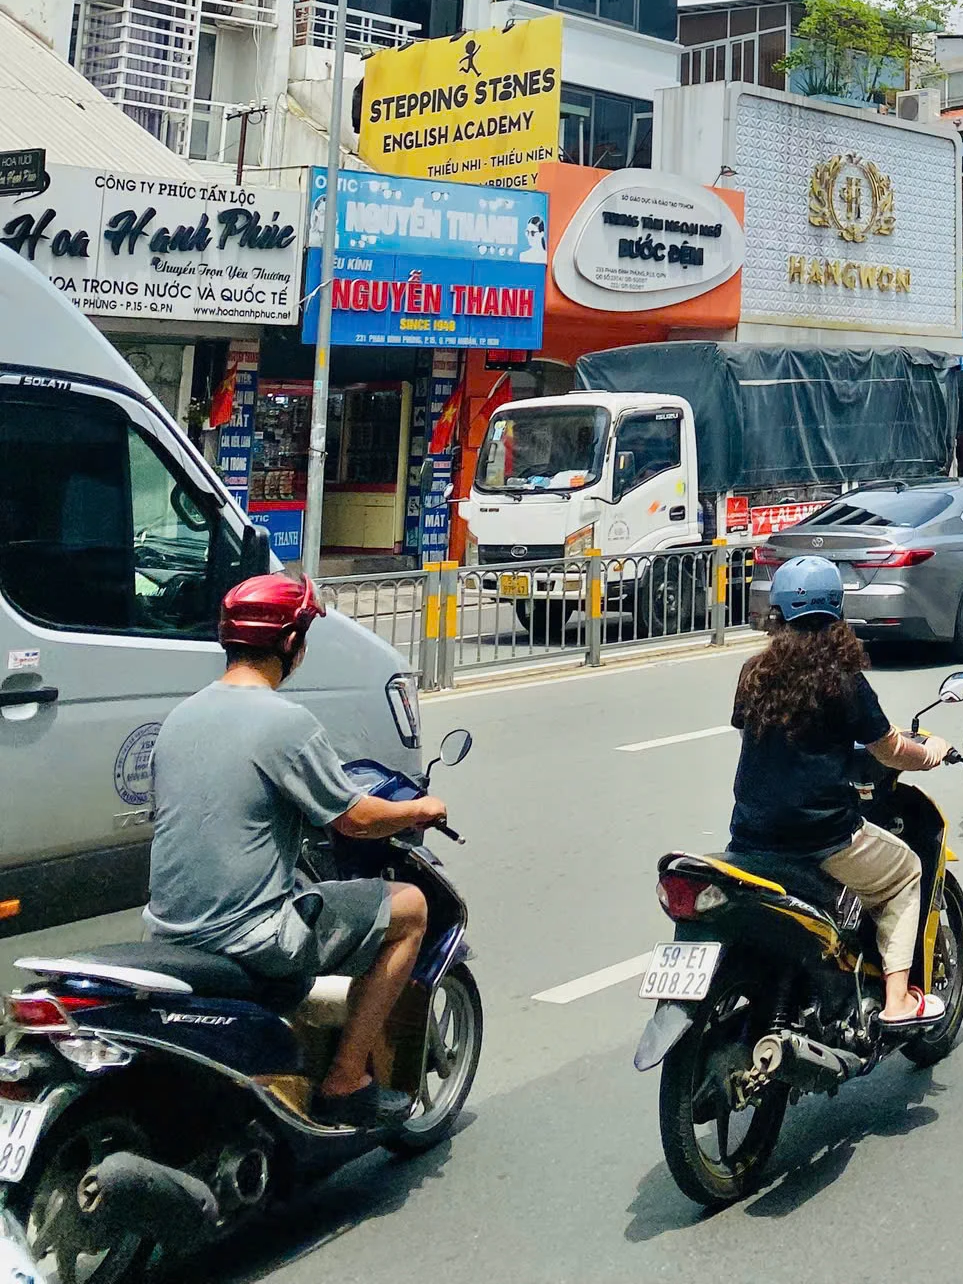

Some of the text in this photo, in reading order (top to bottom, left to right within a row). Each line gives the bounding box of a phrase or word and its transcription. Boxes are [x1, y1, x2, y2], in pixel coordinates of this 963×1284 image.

[369, 84, 469, 123] STEPPING
[383, 110, 534, 153] ENGLISH ACADEMY
[427, 145, 553, 178] THIẾU NHI THIẾU NIÊN
[95, 174, 256, 208] CÔNG TY PHÚC TẤN LỘC
[315, 174, 359, 194] OTIC
[0, 208, 90, 261] Hoa
[216, 207, 297, 251] Phúc
[446, 210, 519, 245] THANH
[347, 257, 373, 273] KÍNH
[788, 256, 912, 294] HANGWON
[48, 275, 288, 305] OA TRONG NƯỚC VÀ QUỐC TẾ
[332, 269, 535, 318] NGUYỄN THANH
[83, 296, 117, 311] PHÙNG
[193, 305, 291, 321] www.hoahanhphuc.net
[400, 317, 431, 332] SINCE
[23, 376, 68, 390] SOLATI
[273, 531, 299, 547] THANH
[659, 946, 707, 969] 59-E1
[645, 971, 706, 996] 908.22
[151, 1008, 238, 1025] VISION
